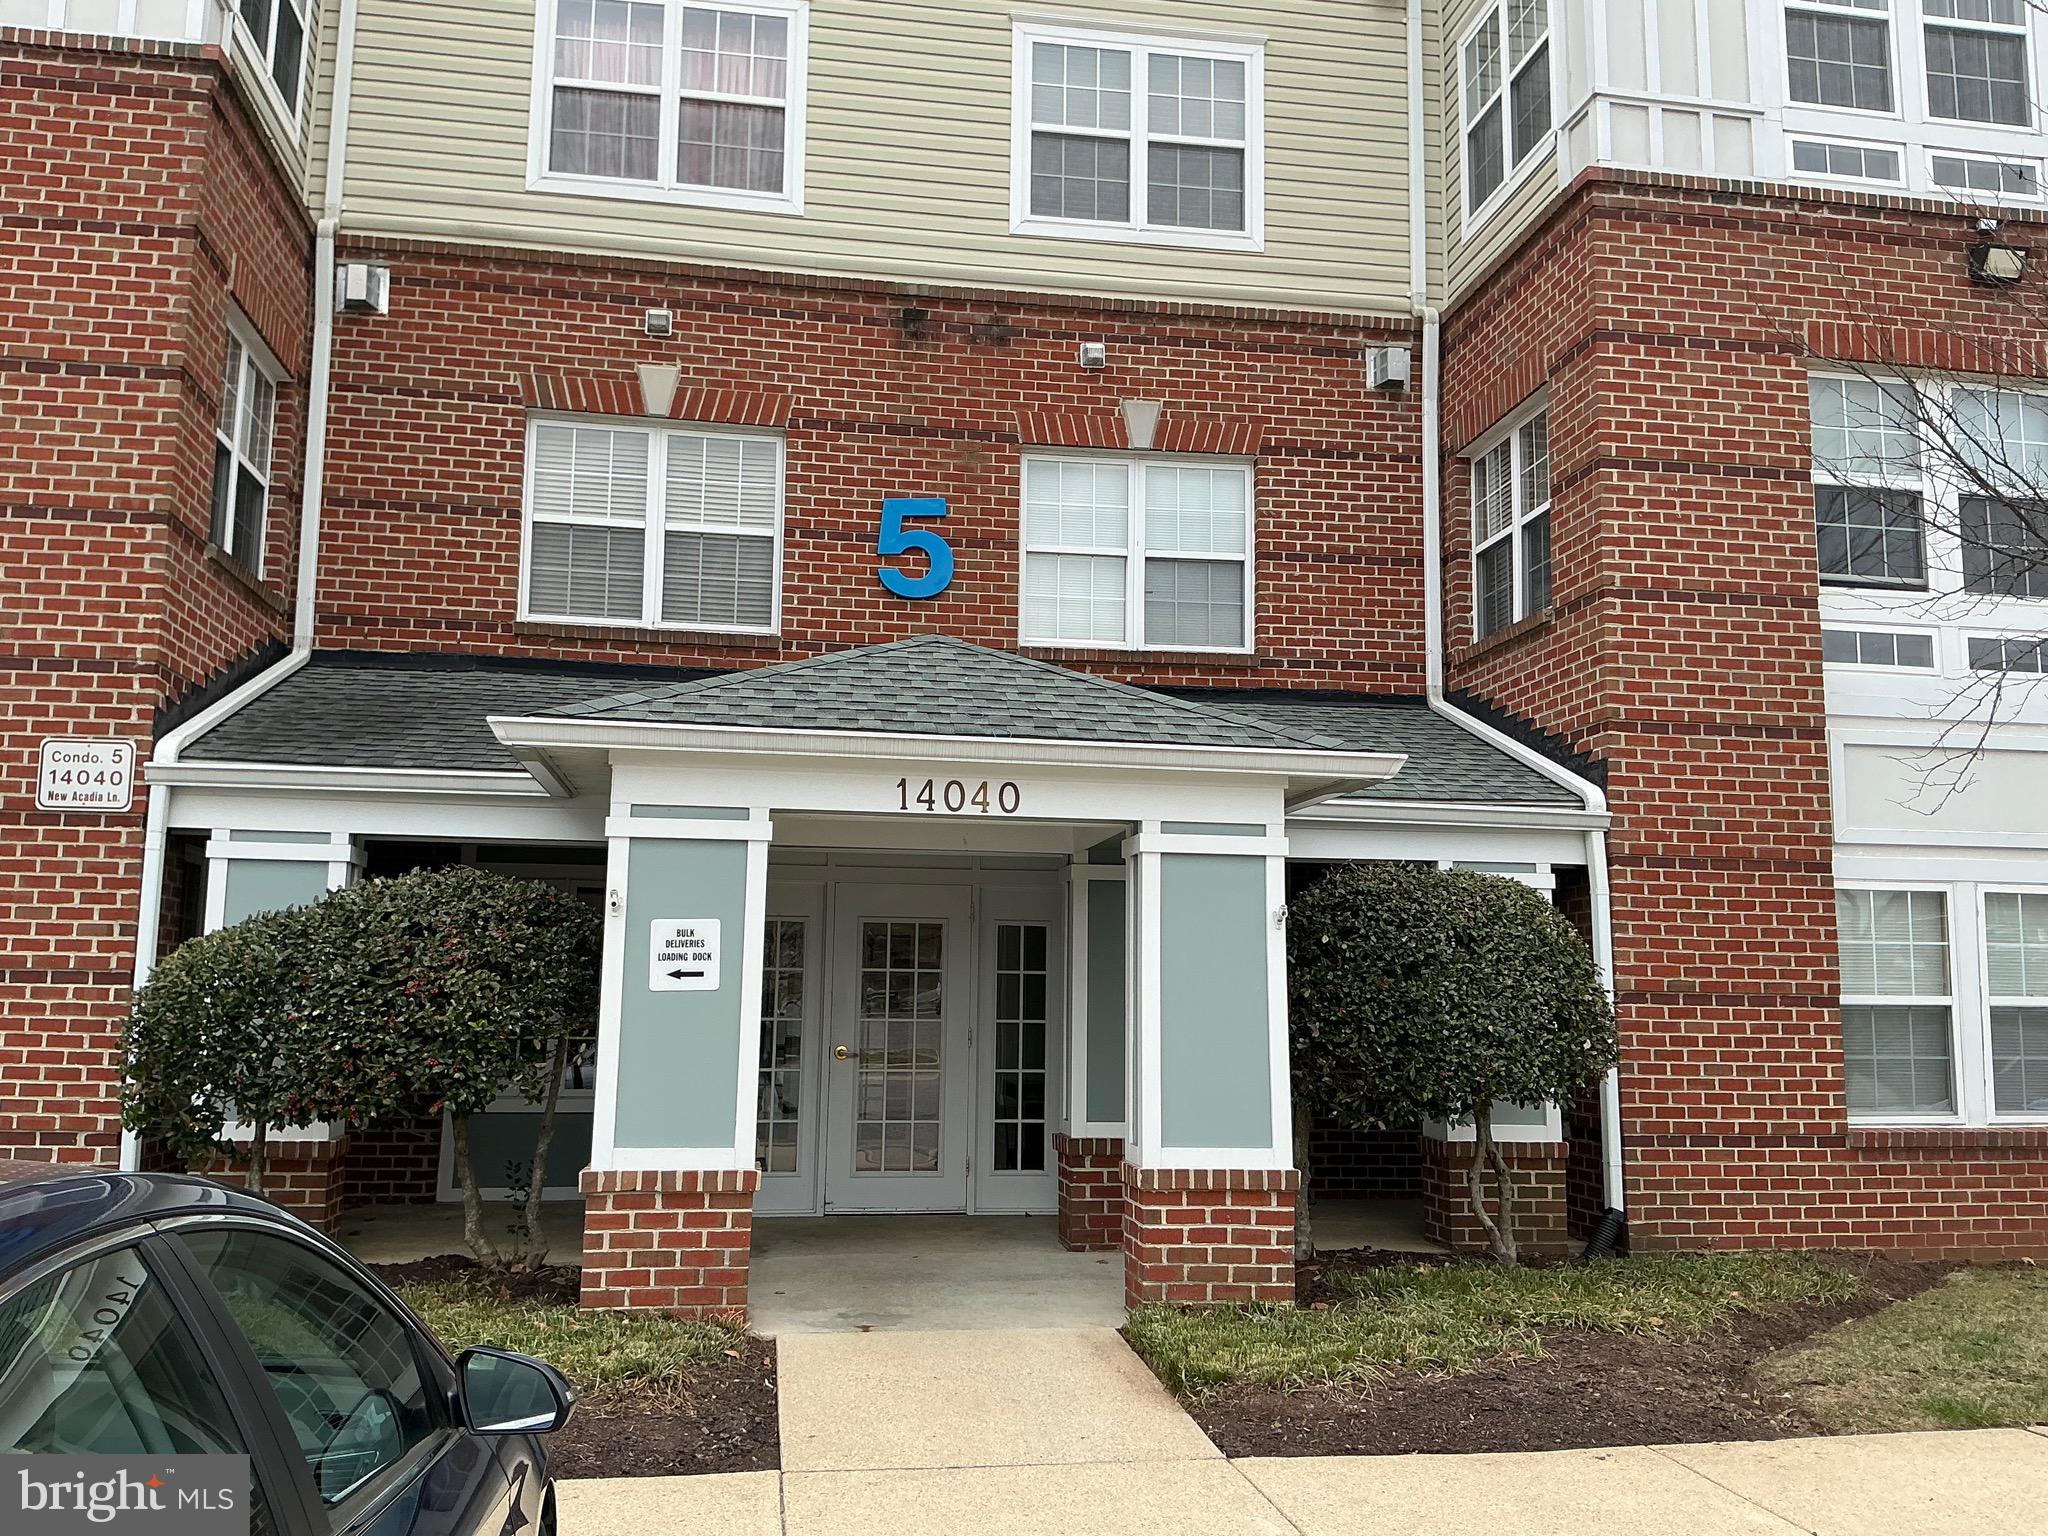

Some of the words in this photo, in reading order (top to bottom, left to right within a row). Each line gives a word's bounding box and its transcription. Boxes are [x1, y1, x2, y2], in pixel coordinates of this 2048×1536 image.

[877, 497, 955, 600] 5
[51, 750, 104, 764] Condo.
[111, 749, 123, 764] 5
[48, 769, 124, 786] 14040
[47, 790, 68, 801] New
[71, 791, 104, 802] Acadia
[106, 791, 121, 803] Ln.
[896, 777, 1021, 814] 14040
[676, 928, 696, 938] BULK
[665, 939, 706, 948] DELIVERIES
[657, 952, 689, 962] LOADING
[692, 952, 713, 962] DOCK
